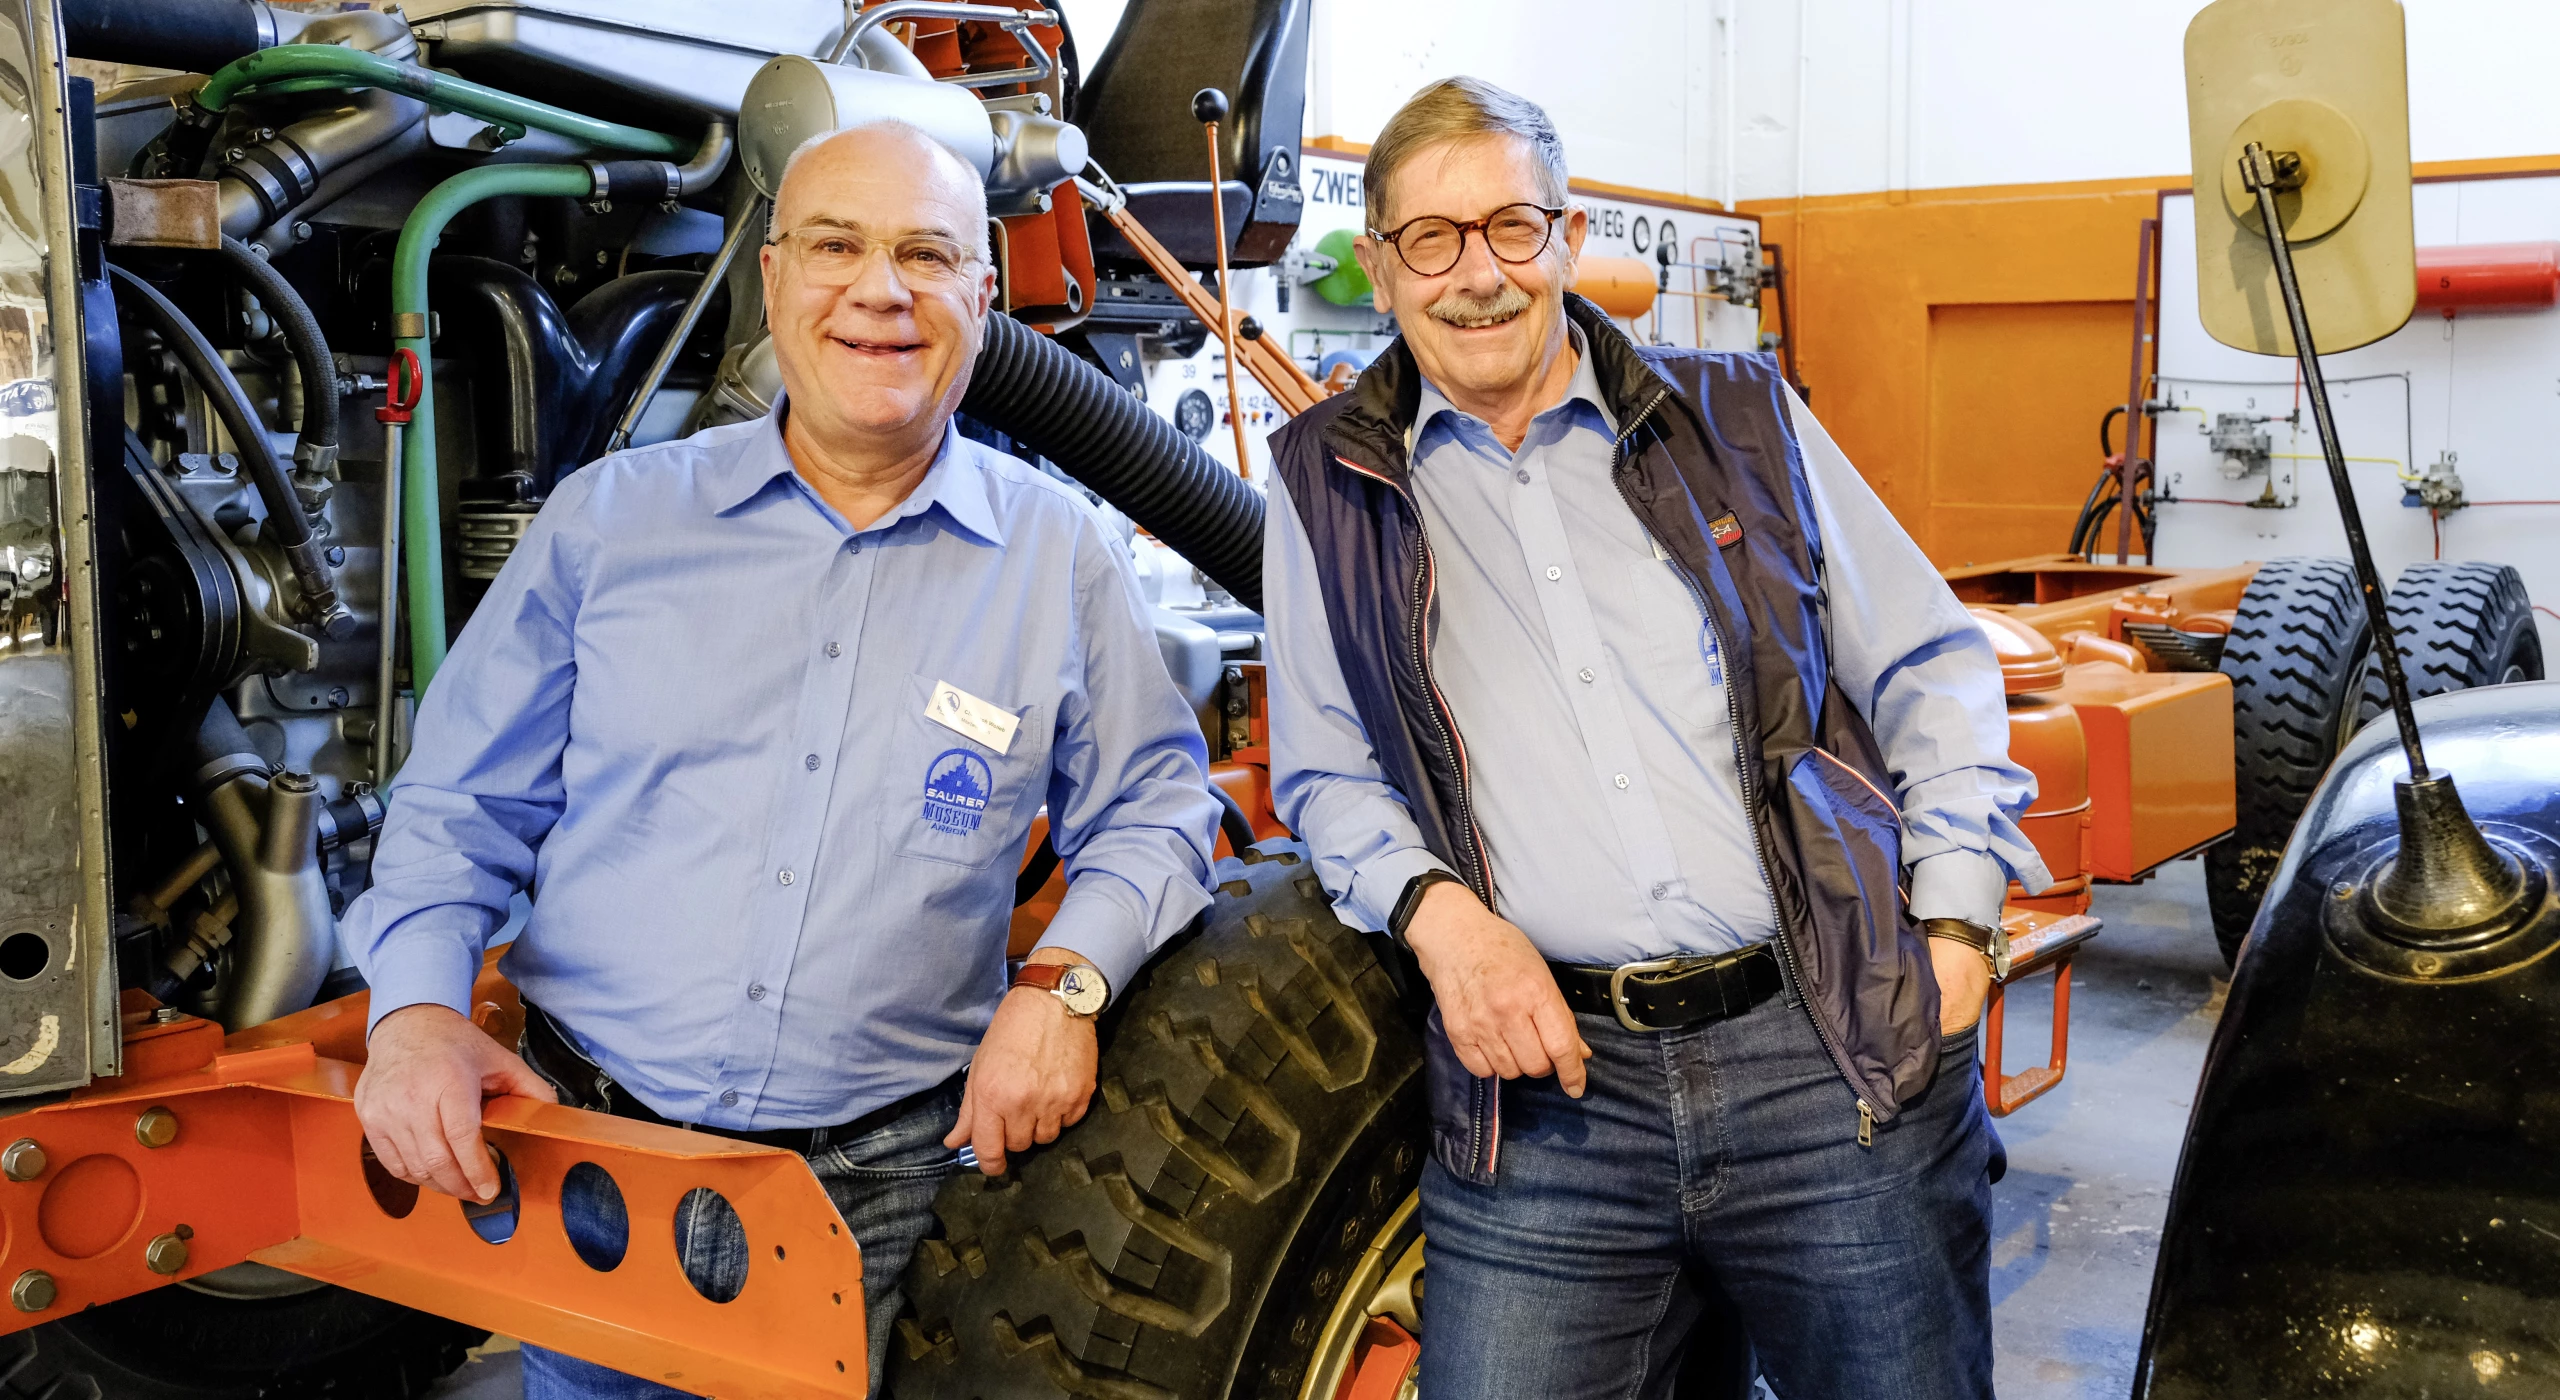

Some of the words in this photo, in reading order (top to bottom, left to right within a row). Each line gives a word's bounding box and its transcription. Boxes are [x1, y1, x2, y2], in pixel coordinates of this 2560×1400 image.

[2440, 275, 2451, 289] 5
[1182, 364, 1196, 379] 39
[2183, 389, 2190, 401] 1
[1247, 396, 1260, 410] 42
[2246, 397, 2256, 410] 3
[2173, 472, 2183, 485] 2
[2282, 473, 2291, 485] 4
[926, 786, 985, 809] SAURER
[922, 801, 983, 830] MUSEUM
[930, 822, 969, 837] ARBON
